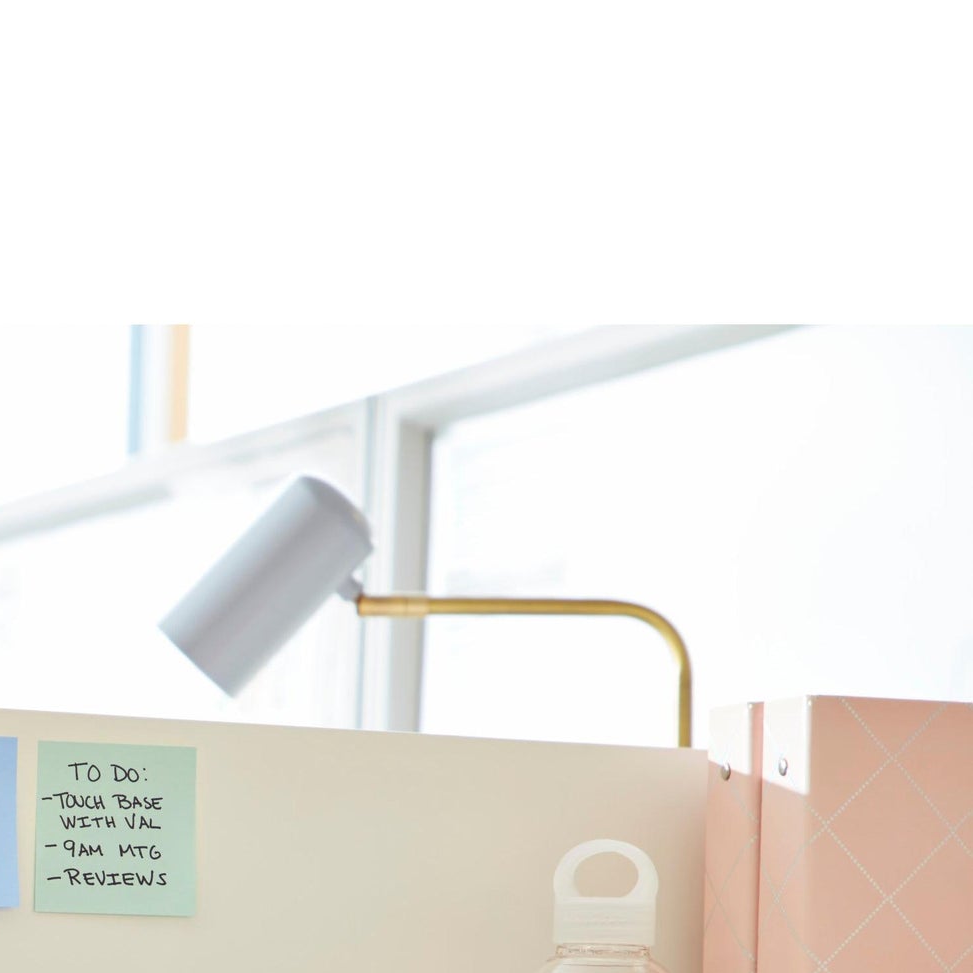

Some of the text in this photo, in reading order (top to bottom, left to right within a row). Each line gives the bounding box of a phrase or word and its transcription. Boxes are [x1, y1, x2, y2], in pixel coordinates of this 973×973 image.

[67, 762, 148, 783] TO DO:
[111, 793, 164, 811] BASE
[59, 812, 162, 830] WITH VAL
[118, 843, 162, 861] MTG
